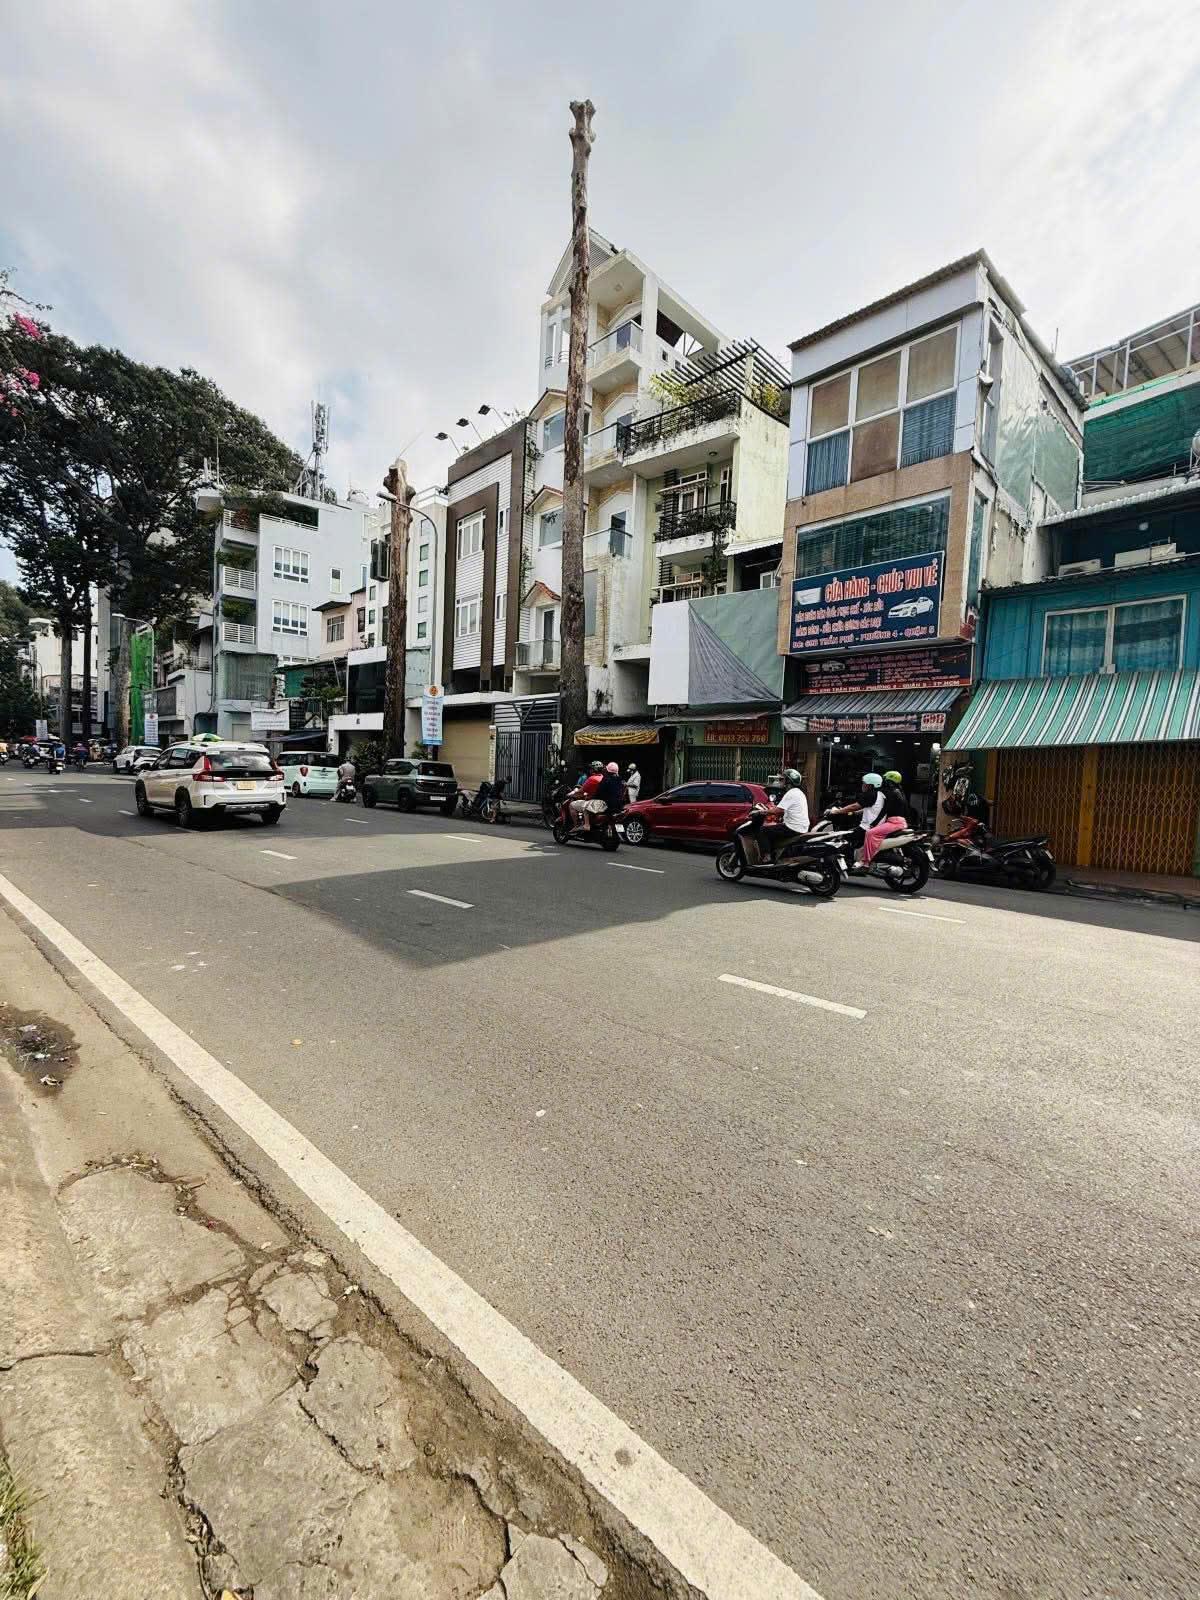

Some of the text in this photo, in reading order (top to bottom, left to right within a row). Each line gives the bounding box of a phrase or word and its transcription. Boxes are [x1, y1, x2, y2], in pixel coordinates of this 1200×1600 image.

[825, 576, 843, 602] CỬA
[843, 576, 870, 600] HÀNG
[877, 568, 904, 594] CHÚC
[905, 569, 922, 589] VUI
[923, 558, 938, 586] VẺ
[820, 635, 838, 646] TRẦN
[839, 633, 854, 644] PHÚ
